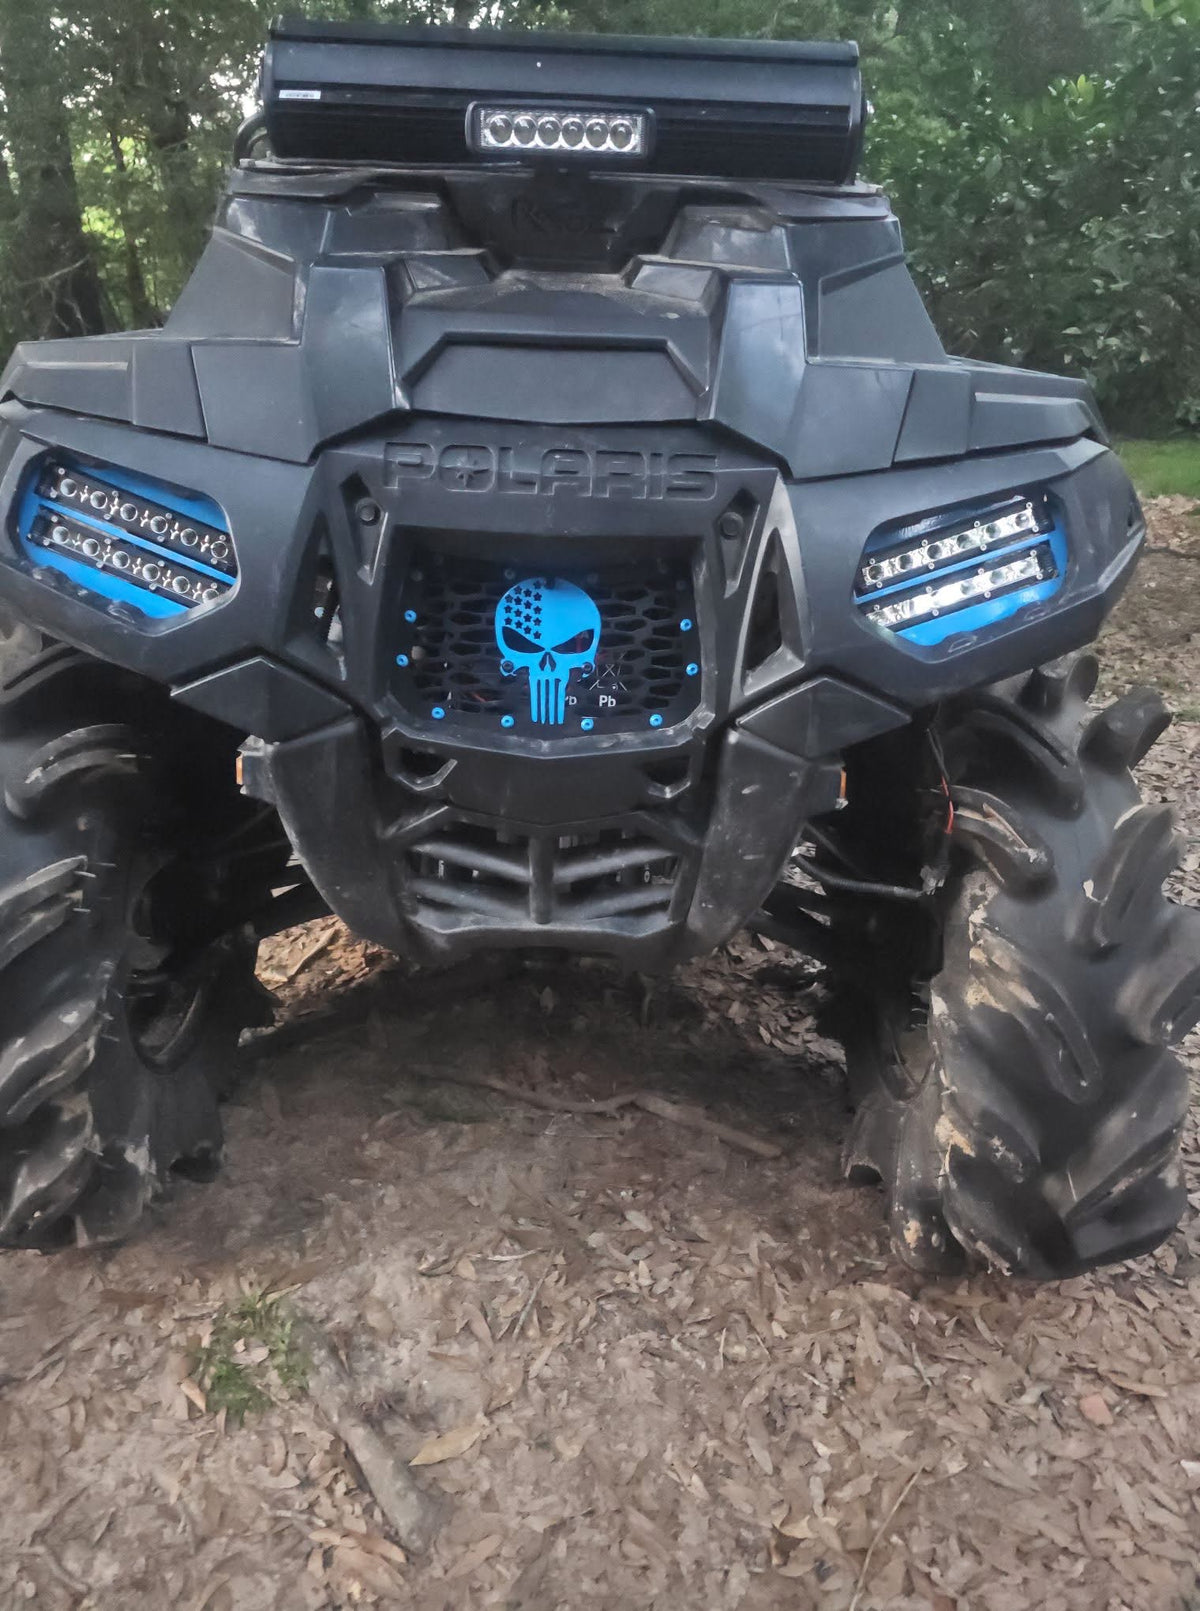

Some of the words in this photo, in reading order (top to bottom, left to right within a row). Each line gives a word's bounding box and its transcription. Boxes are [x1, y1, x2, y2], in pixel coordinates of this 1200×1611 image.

[383, 441, 718, 501] POLARIS
[565, 695, 577, 706] b
[599, 695, 617, 707] Pb
